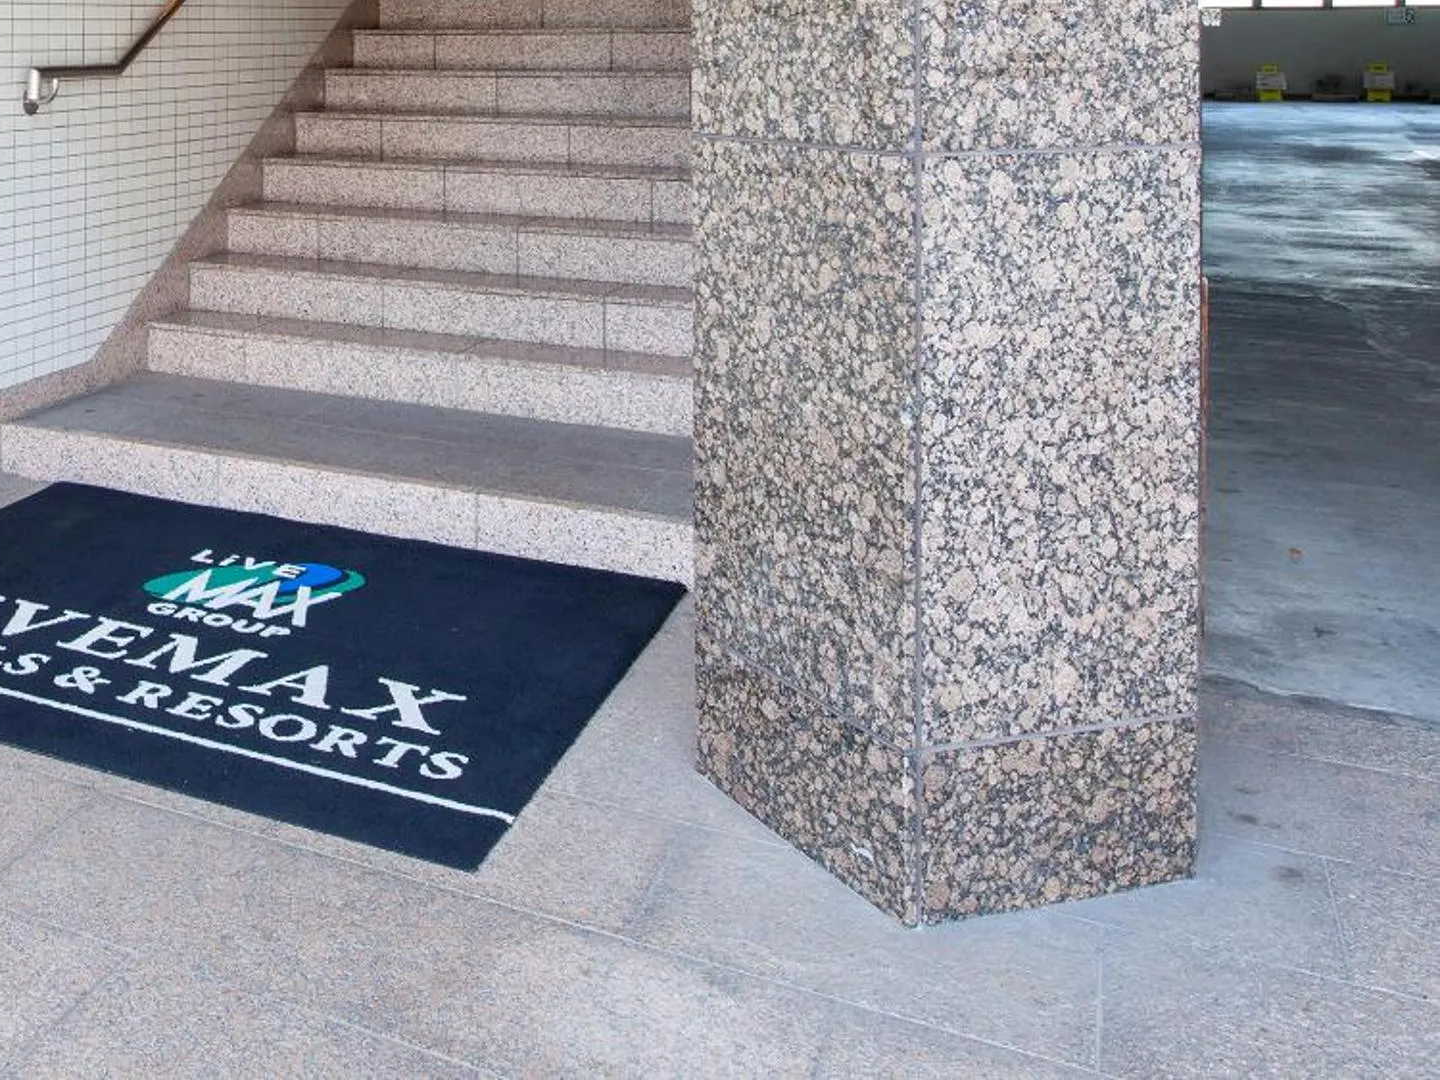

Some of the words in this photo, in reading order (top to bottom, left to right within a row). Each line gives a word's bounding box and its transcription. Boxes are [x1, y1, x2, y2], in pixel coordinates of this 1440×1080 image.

[146, 602, 291, 638] GROUP
[162, 569, 343, 628] MAX
[53, 665, 112, 695] &
[115, 680, 470, 781] RESORTS
